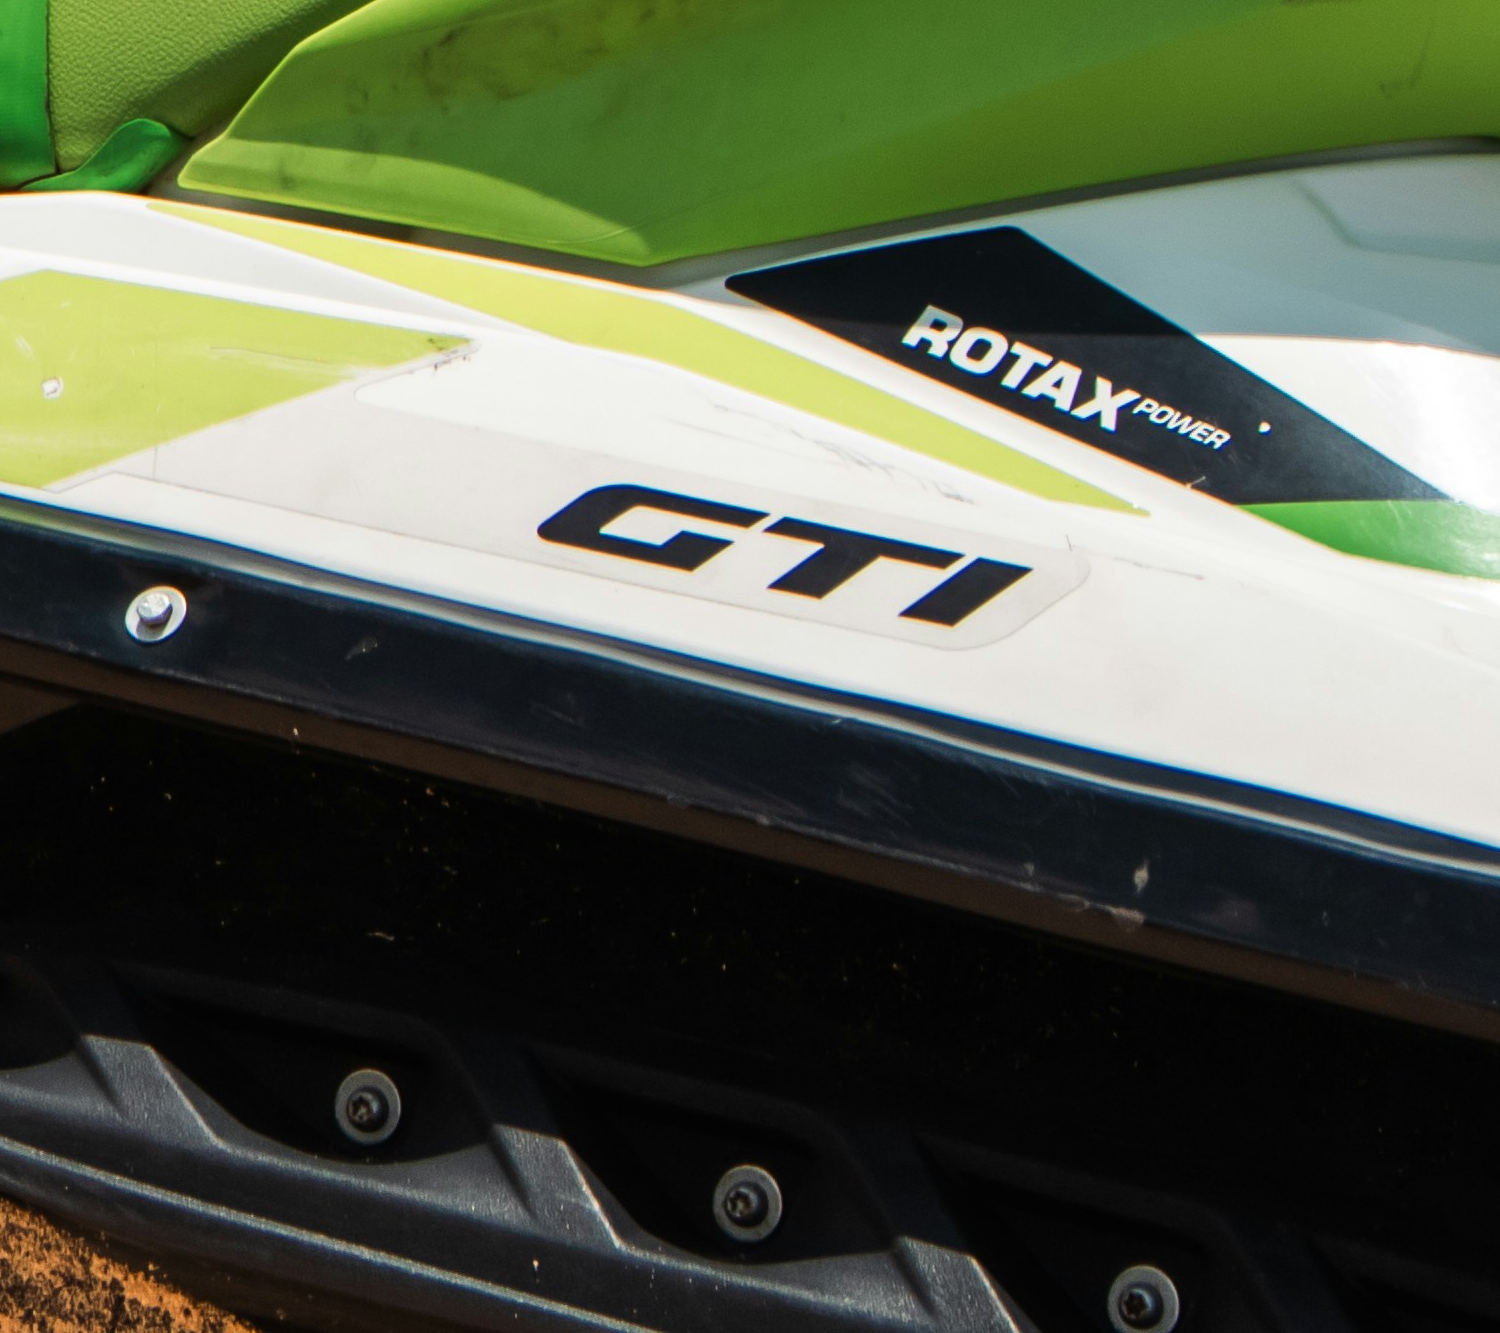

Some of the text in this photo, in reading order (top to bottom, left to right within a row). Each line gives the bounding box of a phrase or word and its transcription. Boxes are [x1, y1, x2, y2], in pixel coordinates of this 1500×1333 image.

[901, 304, 1233, 451] ROTAX POWER
[536, 483, 1032, 628] GTI
